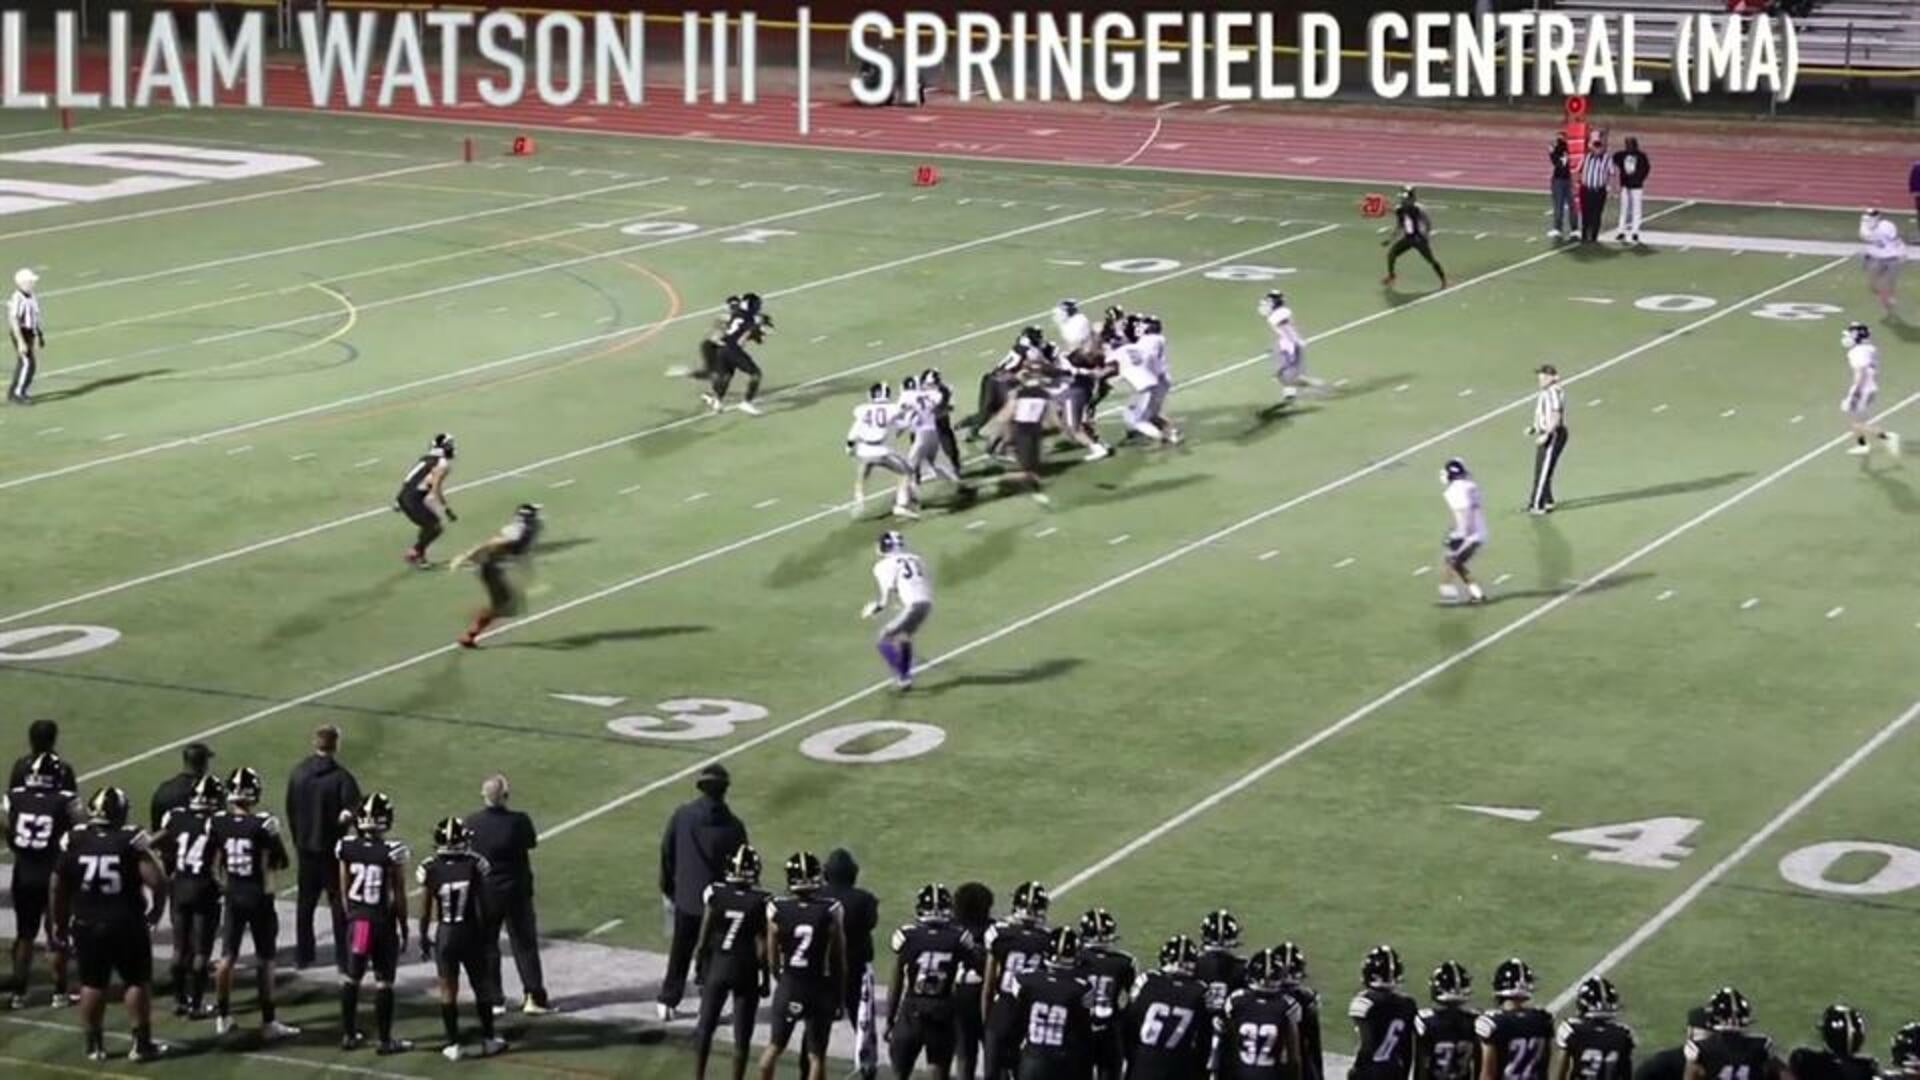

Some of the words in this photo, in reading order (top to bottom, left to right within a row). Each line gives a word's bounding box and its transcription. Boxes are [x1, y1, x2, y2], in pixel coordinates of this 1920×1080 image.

[607, 697, 946, 762] 30
[78, 855, 121, 894] 75
[176, 832, 208, 874] 14
[1549, 816, 1920, 894] 40
[439, 880, 470, 923] 17
[721, 910, 745, 950] 7
[789, 924, 814, 967] 2
[1140, 1002, 1194, 1048] 67
[1239, 1022, 1278, 1066] 32
